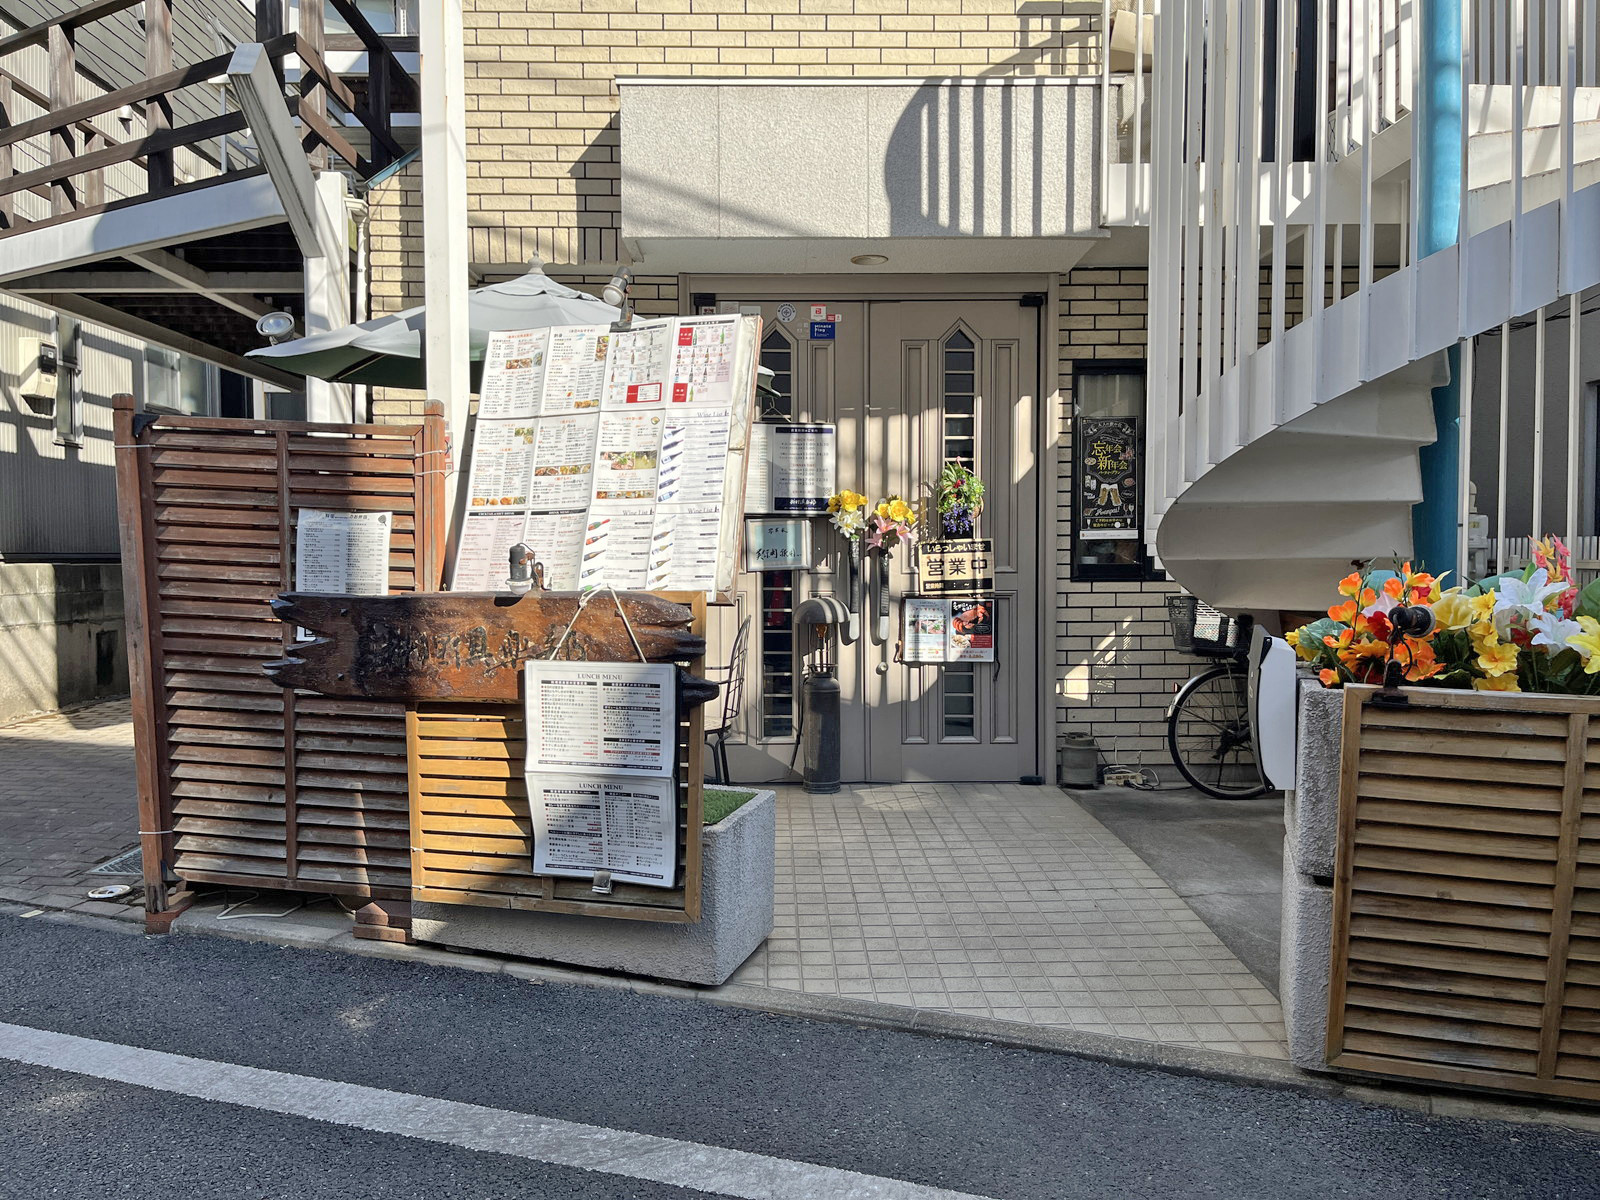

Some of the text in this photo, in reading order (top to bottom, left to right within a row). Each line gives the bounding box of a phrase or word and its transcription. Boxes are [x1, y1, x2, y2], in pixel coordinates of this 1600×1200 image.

[1091, 441, 1122, 458] 忘年会
[1097, 455, 1128, 470] 新年会
[927, 542, 985, 553] いらっしゃいませ
[926, 556, 988, 576] 営業中
